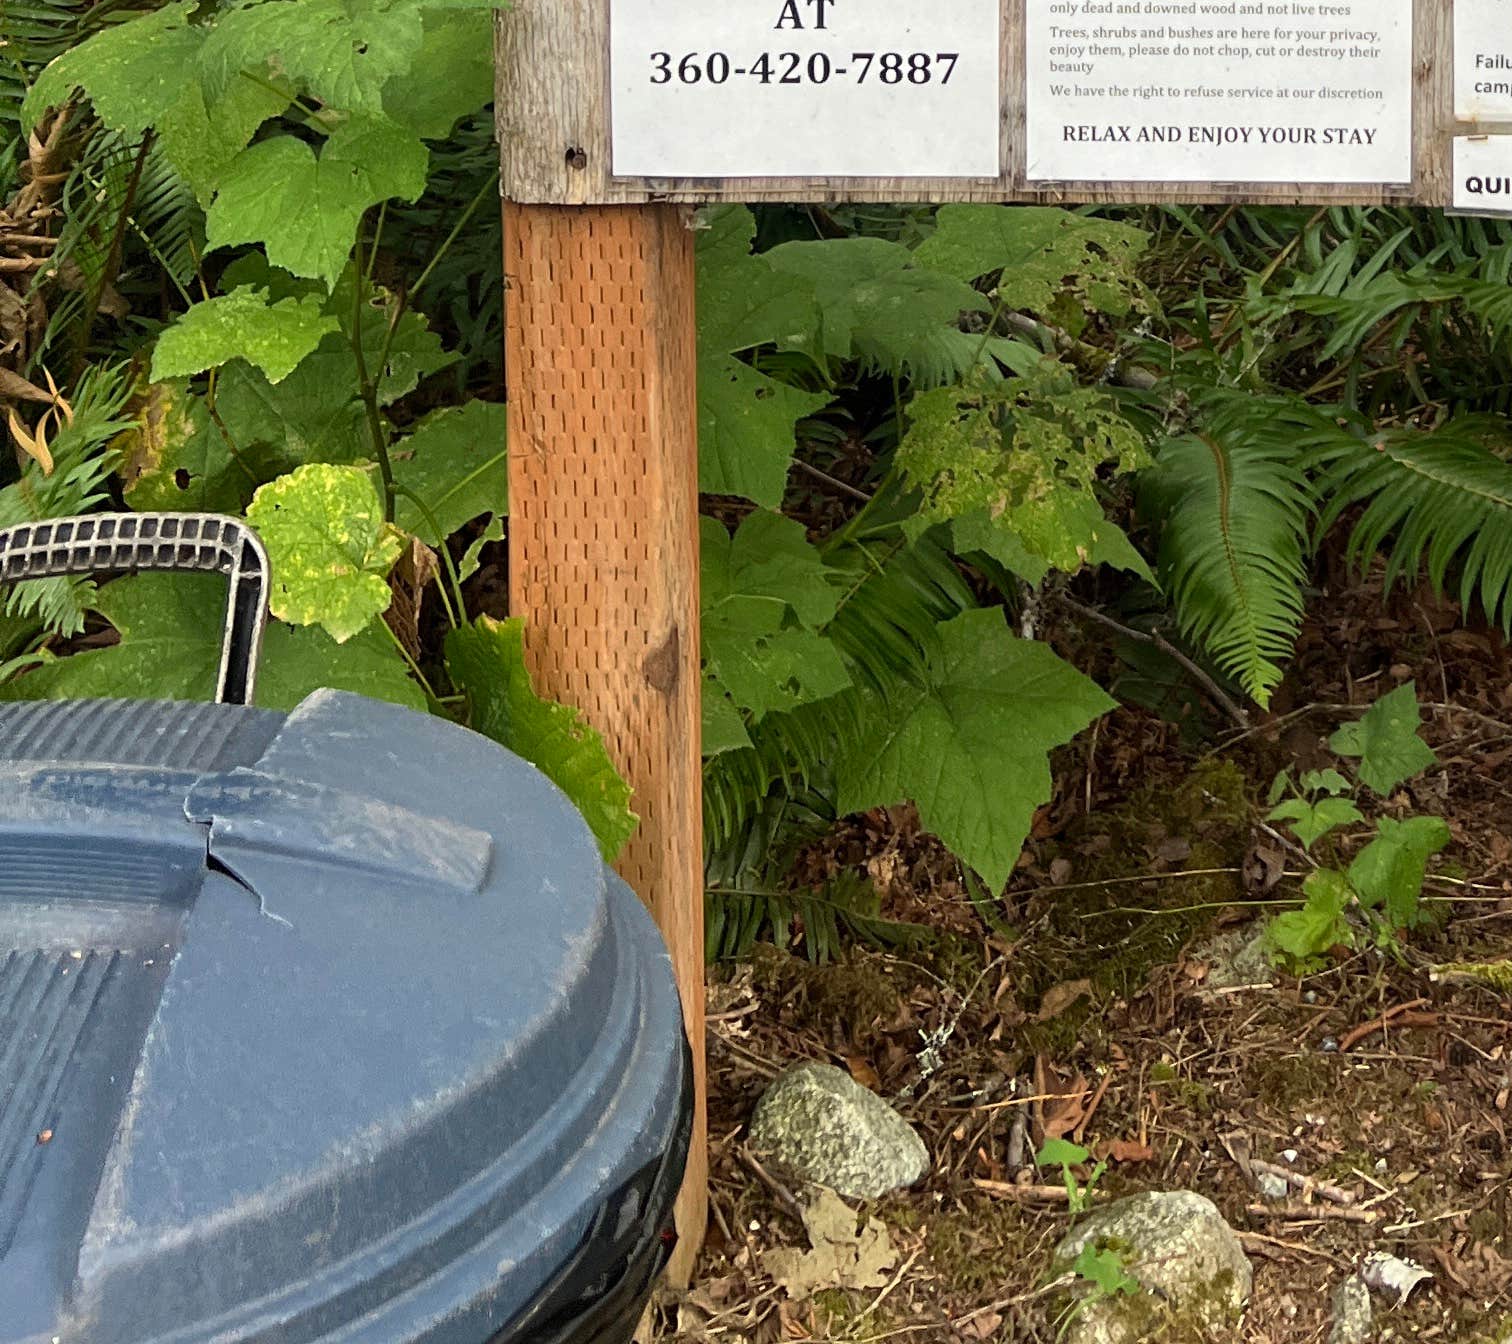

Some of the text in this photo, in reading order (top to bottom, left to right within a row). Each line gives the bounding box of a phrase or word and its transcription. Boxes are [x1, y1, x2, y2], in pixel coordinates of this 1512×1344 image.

[650, 51, 959, 84] 360-420-7887
[1063, 125, 1376, 146] RELAX AND ENJOY YOUR STAY
